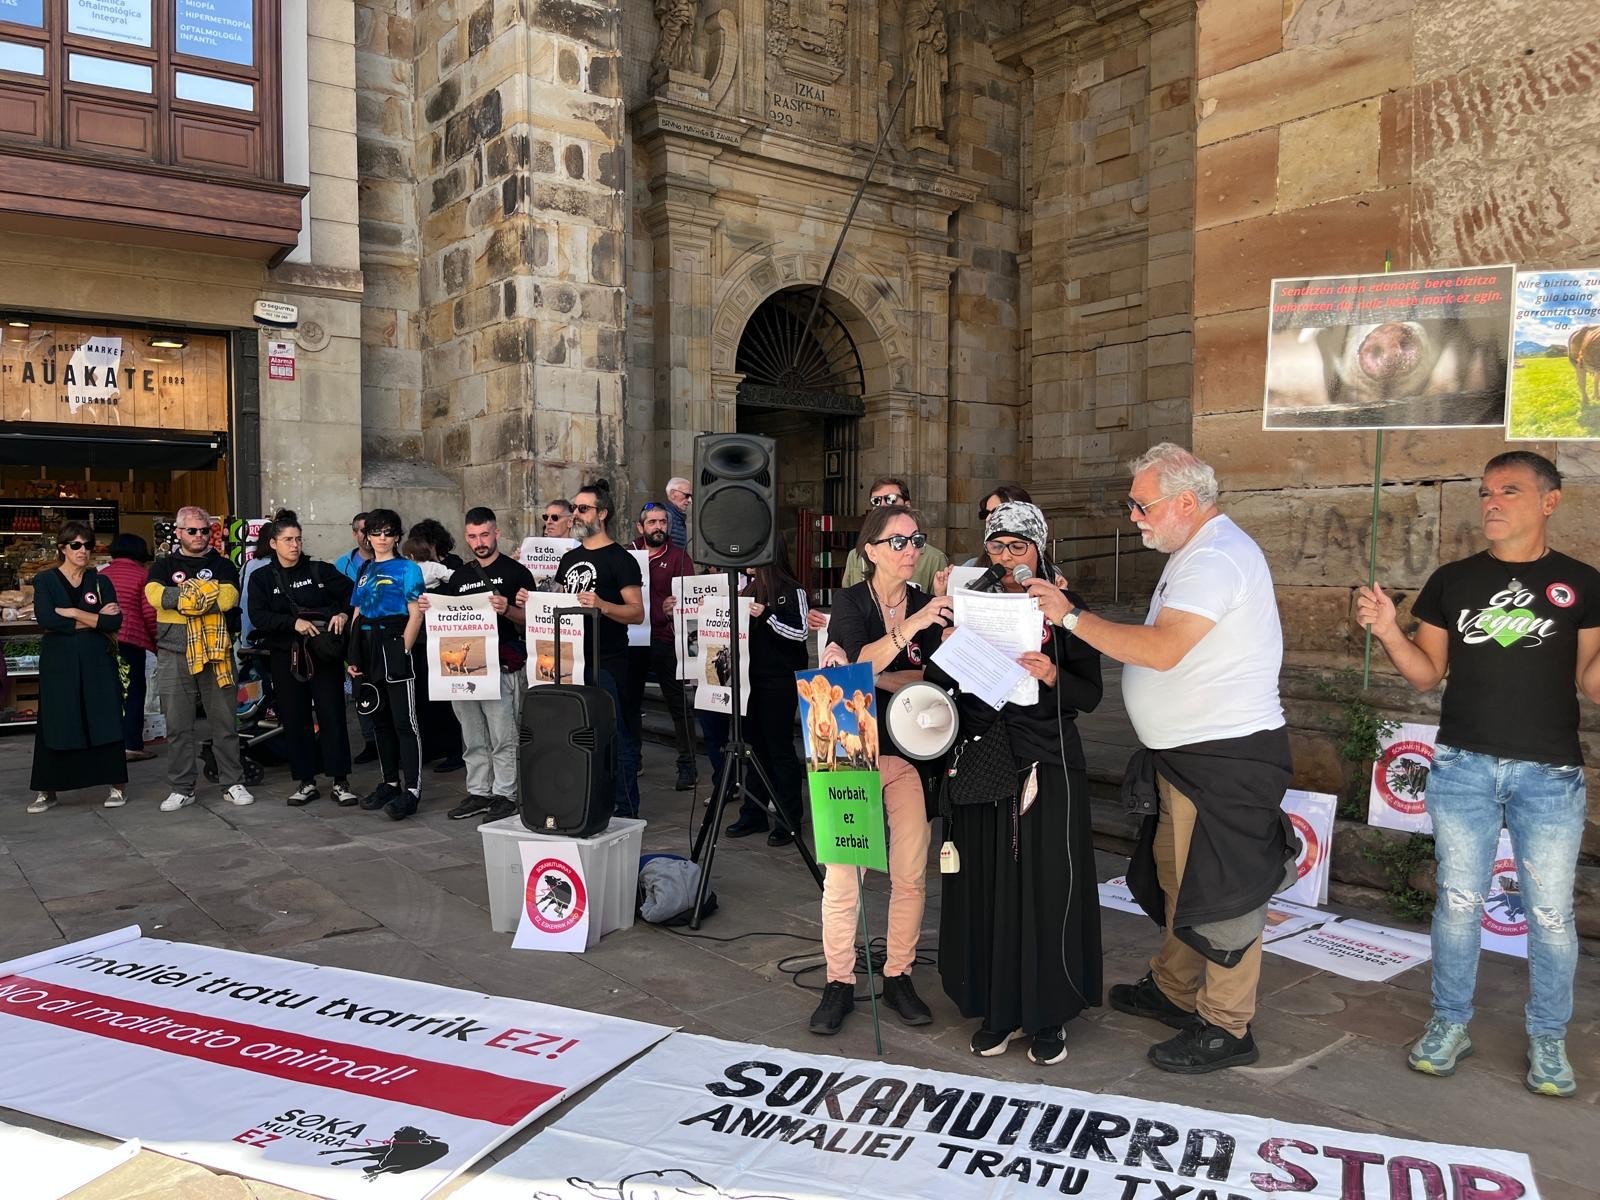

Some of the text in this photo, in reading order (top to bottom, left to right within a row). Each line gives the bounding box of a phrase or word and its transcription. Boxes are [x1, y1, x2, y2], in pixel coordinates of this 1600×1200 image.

[78, 0, 142, 18] Oftalmológica
[92, 11, 128, 25] Integral
[185, 10, 251, 30] HIPERMETROPÍA
[180, 24, 243, 42] OFTALMOLOGÍA
[180, 33, 218, 46] INFANTIL
[795, 82, 825, 102] IZKAI
[1337, 284, 1366, 294] duen
[1424, 277, 1453, 289] bere
[1455, 274, 1497, 287] bizitza
[1517, 280, 1541, 289] Nire
[1456, 293, 1471, 305] ez
[1473, 290, 1504, 305] egin.
[1561, 292, 1593, 302] baino
[267, 302, 295, 313] segurma
[1554, 322, 1572, 331] da.
[86, 343, 125, 358] MARKET
[22, 358, 155, 392] AÜAKATE
[60, 395, 119, 406] IN DURANGO
[534, 546, 555, 554] Ez da
[692, 585, 718, 595] Ez da
[446, 604, 474, 612] Ez da
[542, 604, 552, 614] Ez
[715, 608, 724, 617] Ez
[437, 612, 485, 622] tradizioa,
[428, 623, 495, 632] TRATU TXARRA DA
[528, 626, 546, 635] TRATU
[572, 629, 583, 637] DA
[1456, 608, 1558, 647] Vegan
[828, 785, 868, 803] Norbait,
[843, 813, 855, 824] ez
[835, 833, 870, 850] zerbait
[1316, 930, 1412, 961] ES TORTURA
[1384, 956, 1403, 965] no
[36, 1000, 88, 1018] al
[91, 1007, 242, 1049] maltrato
[196, 977, 319, 1010] tratu
[315, 997, 490, 1042] txarrik
[484, 1027, 581, 1061] EZ!
[256, 1121, 348, 1148] MUTURRA
[705, 1060, 1526, 1200] SOKAMUTURRA STOP
[232, 1127, 284, 1149] EZ
[678, 1103, 916, 1161] ANIMALIEI
[937, 1142, 1090, 1196] TRATU
